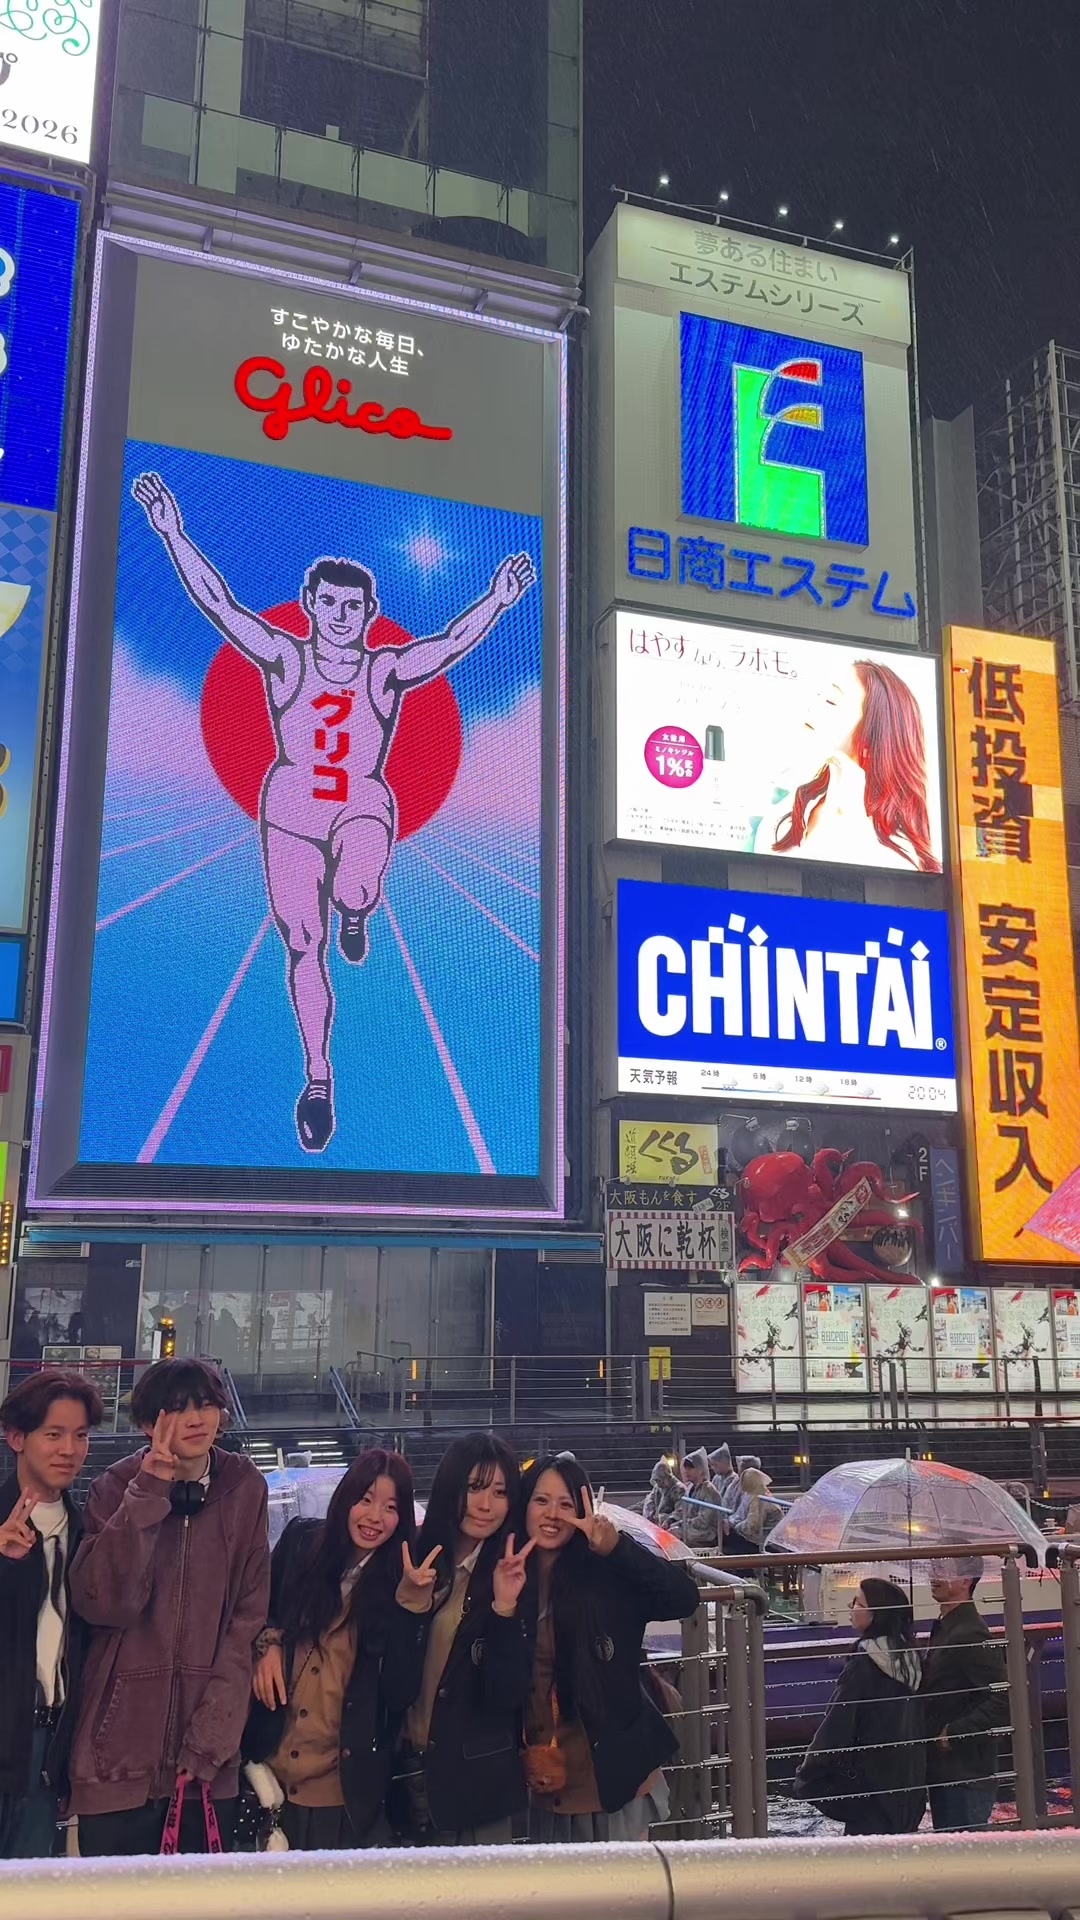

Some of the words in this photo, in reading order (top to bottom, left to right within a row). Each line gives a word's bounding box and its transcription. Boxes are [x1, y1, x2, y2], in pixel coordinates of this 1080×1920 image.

[694, 229, 838, 282] 夢ある住まい
[669, 261, 864, 326] エステムシリーズ
[270, 307, 425, 358] すこやかな毎日、
[281, 332, 410, 376] ゆたかな人生
[234, 356, 453, 441] Glico
[628, 526, 918, 620] 日商エステム
[310, 688, 355, 803] グリコ
[979, 902, 1053, 1194] 安定収入
[629, 1068, 678, 1086] 天気予報
[638, 1129, 699, 1176] くくる
[918, 1146, 929, 1182] 2F
[609, 1188, 697, 1207] 大阪もんを食す
[615, 1220, 717, 1260] 大阪に乾杯
